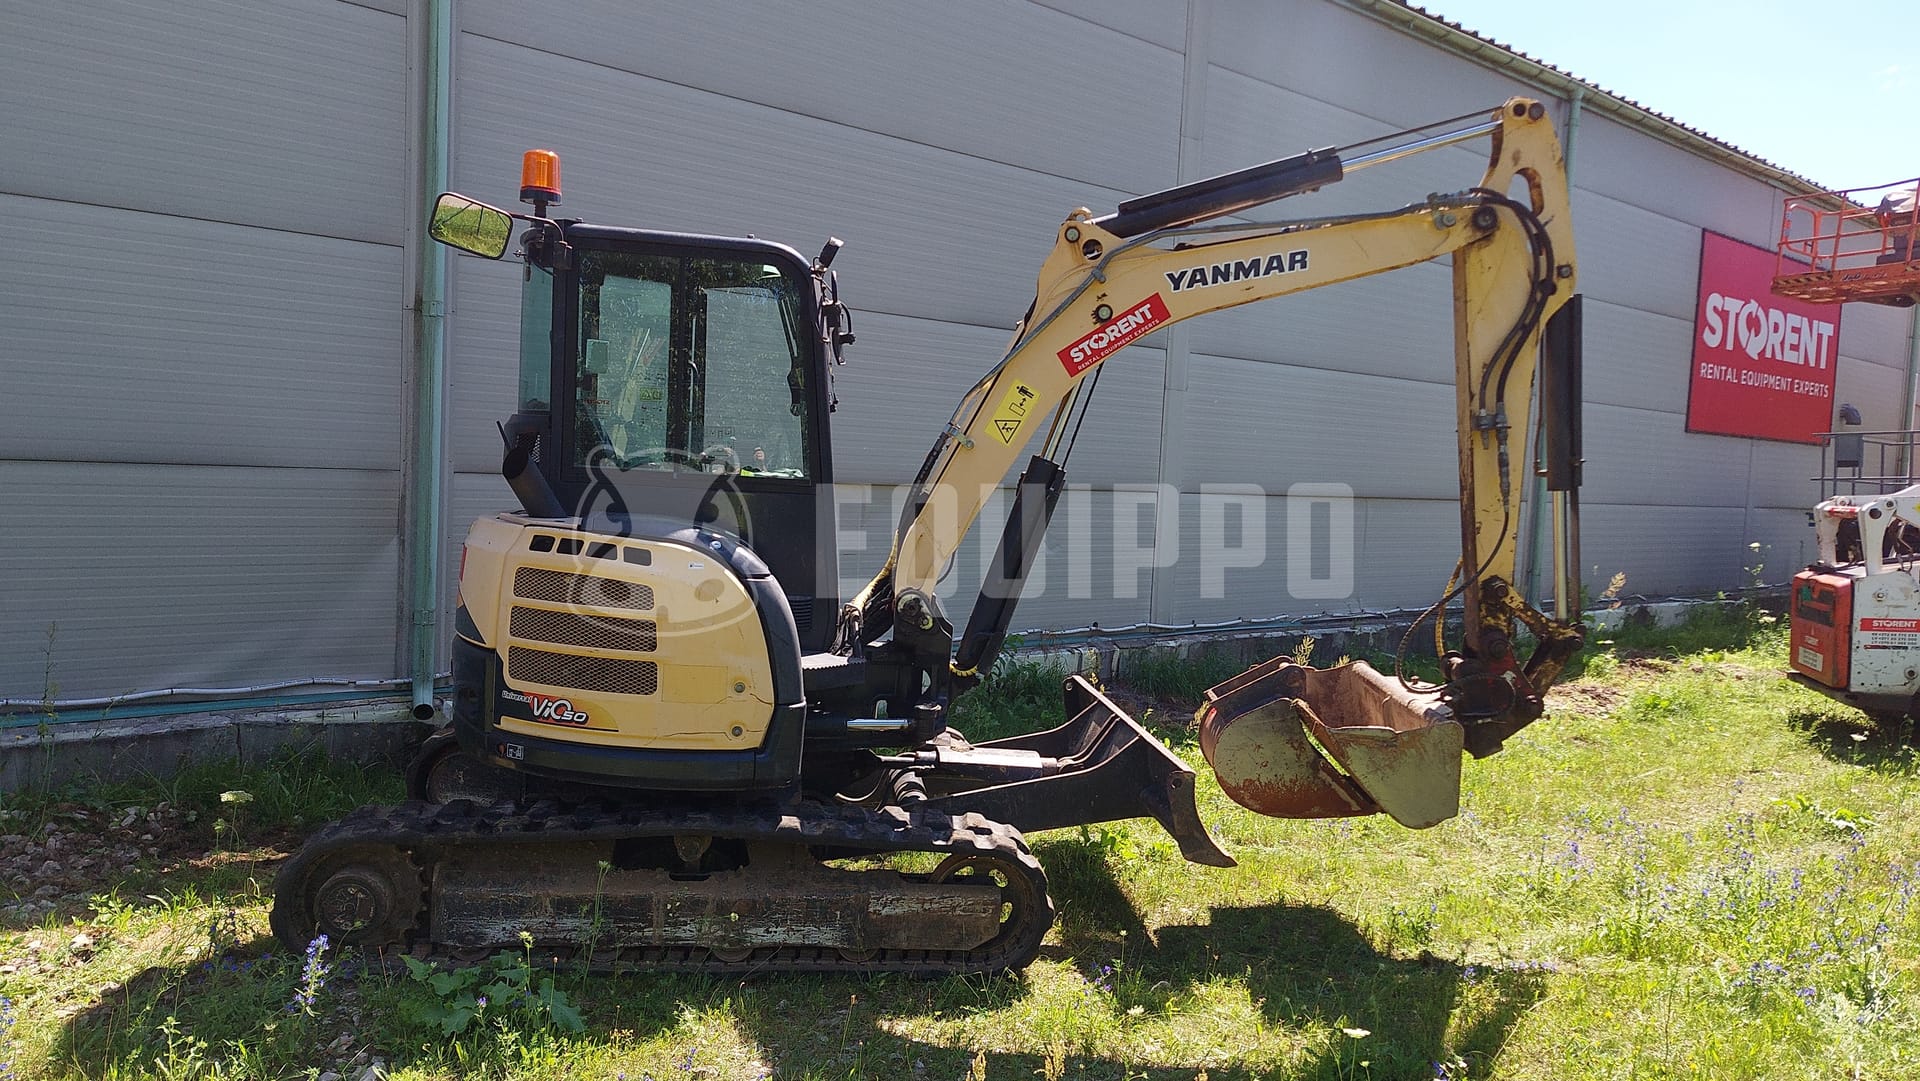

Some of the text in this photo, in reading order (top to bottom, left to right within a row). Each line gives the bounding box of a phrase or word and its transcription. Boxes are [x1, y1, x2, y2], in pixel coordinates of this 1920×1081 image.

[1166, 250, 1308, 291] YANMAR
[1069, 303, 1152, 363] STORENT
[1077, 318, 1160, 371] RENTAL EQUIPMENT EXPERTS
[1703, 292, 1835, 370] STORENT
[1700, 362, 1829, 398] RENTAL EQUIPMENT EXPERTS
[1872, 619, 1917, 628] STORENT
